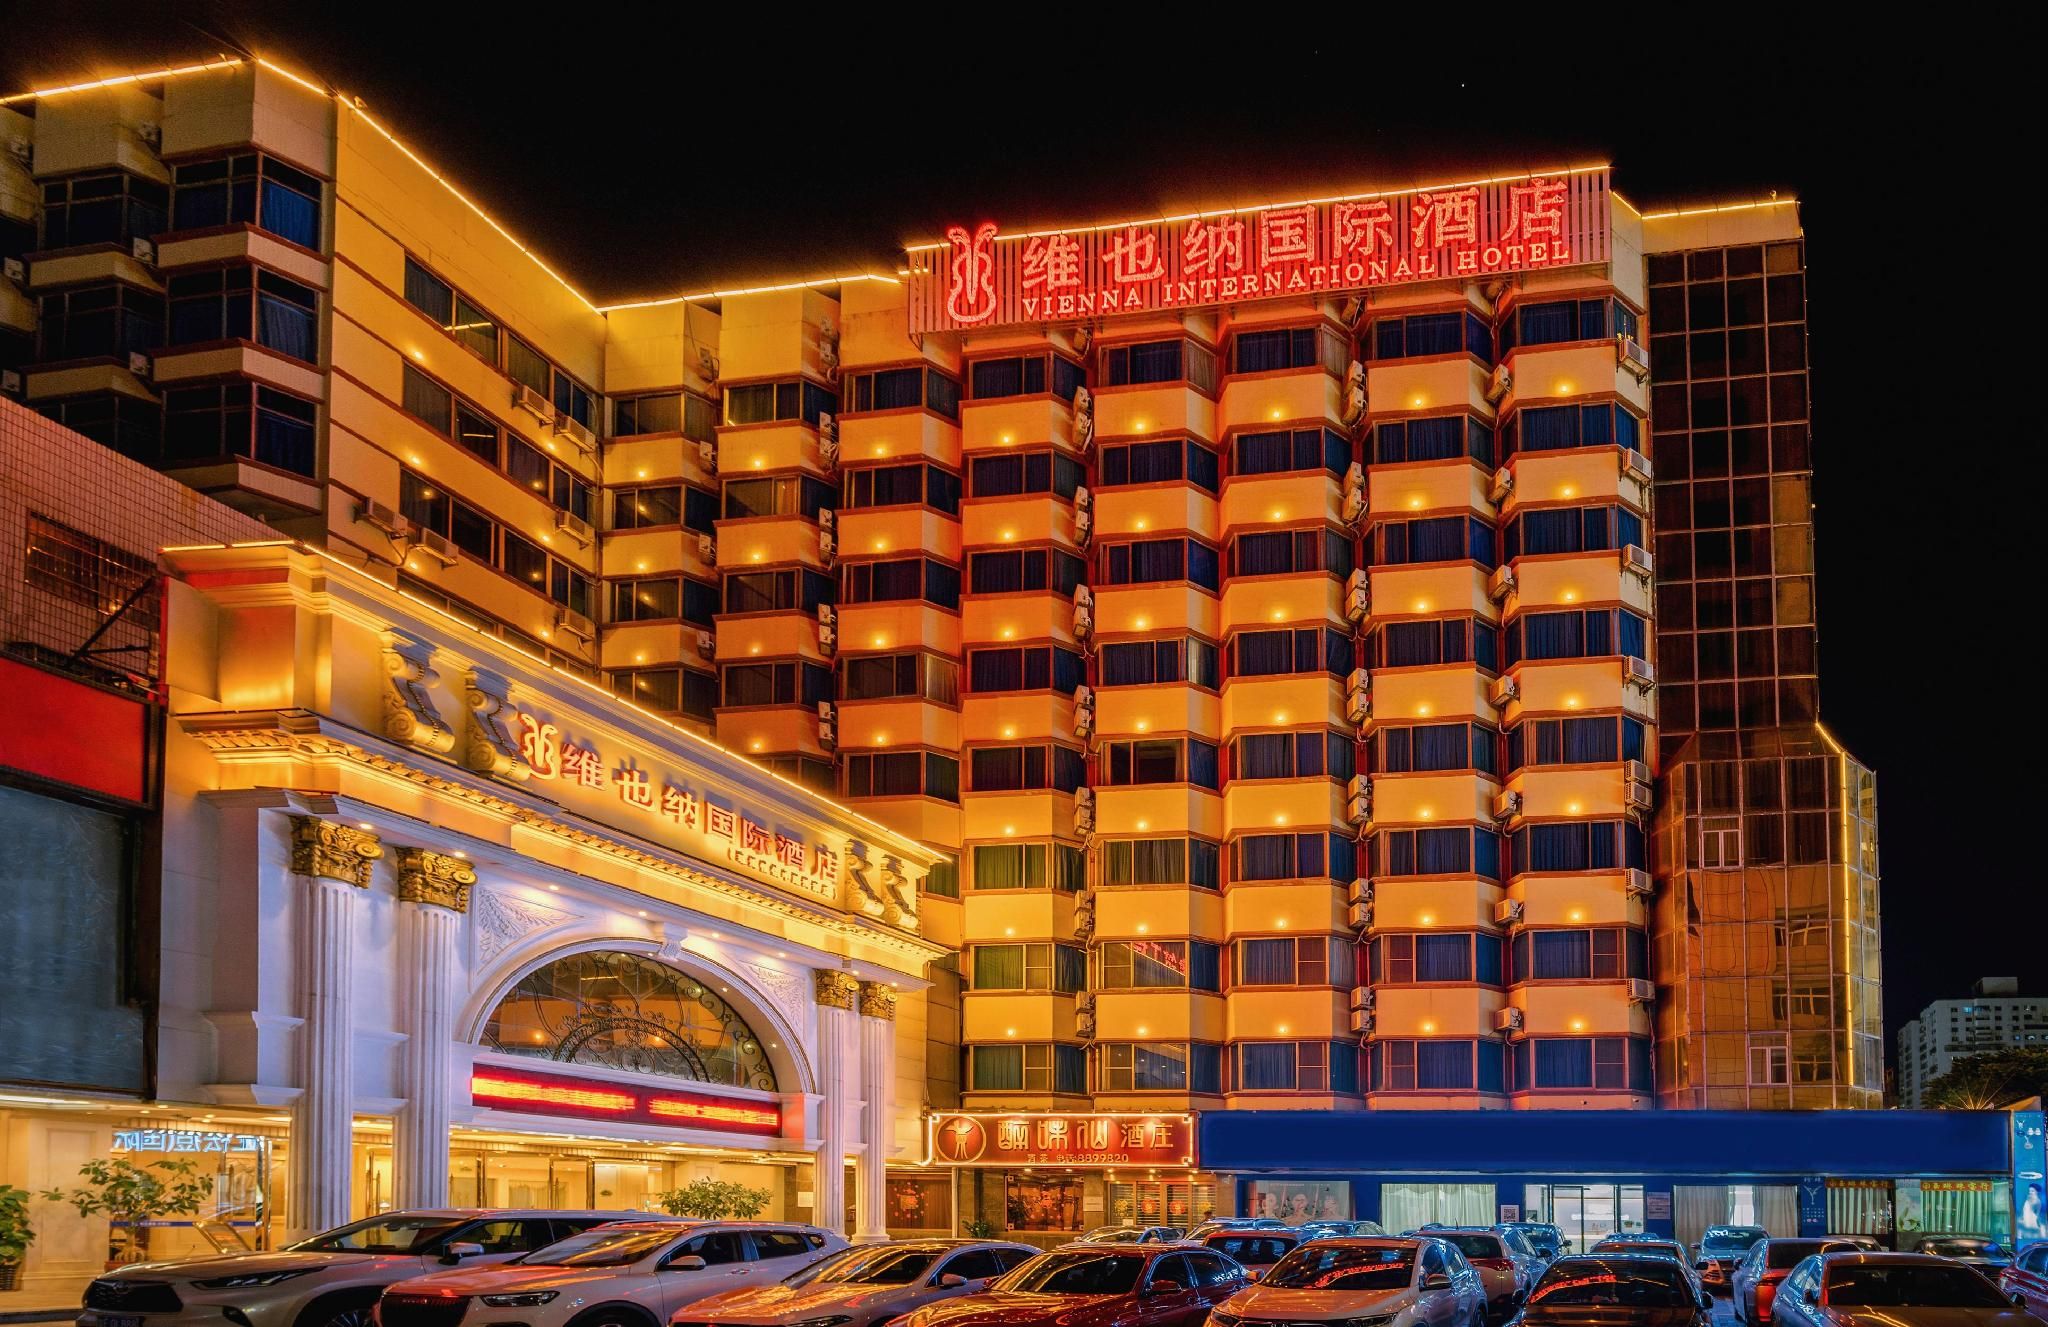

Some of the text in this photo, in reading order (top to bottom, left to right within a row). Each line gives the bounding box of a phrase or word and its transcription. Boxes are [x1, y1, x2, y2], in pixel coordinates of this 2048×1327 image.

[1022, 177, 1569, 292] 维也纳国际酒店
[1022, 241, 1569, 317] VIENNA INTERNATIONAL HOTEL
[560, 743, 839, 881] 维也纳国际酒店
